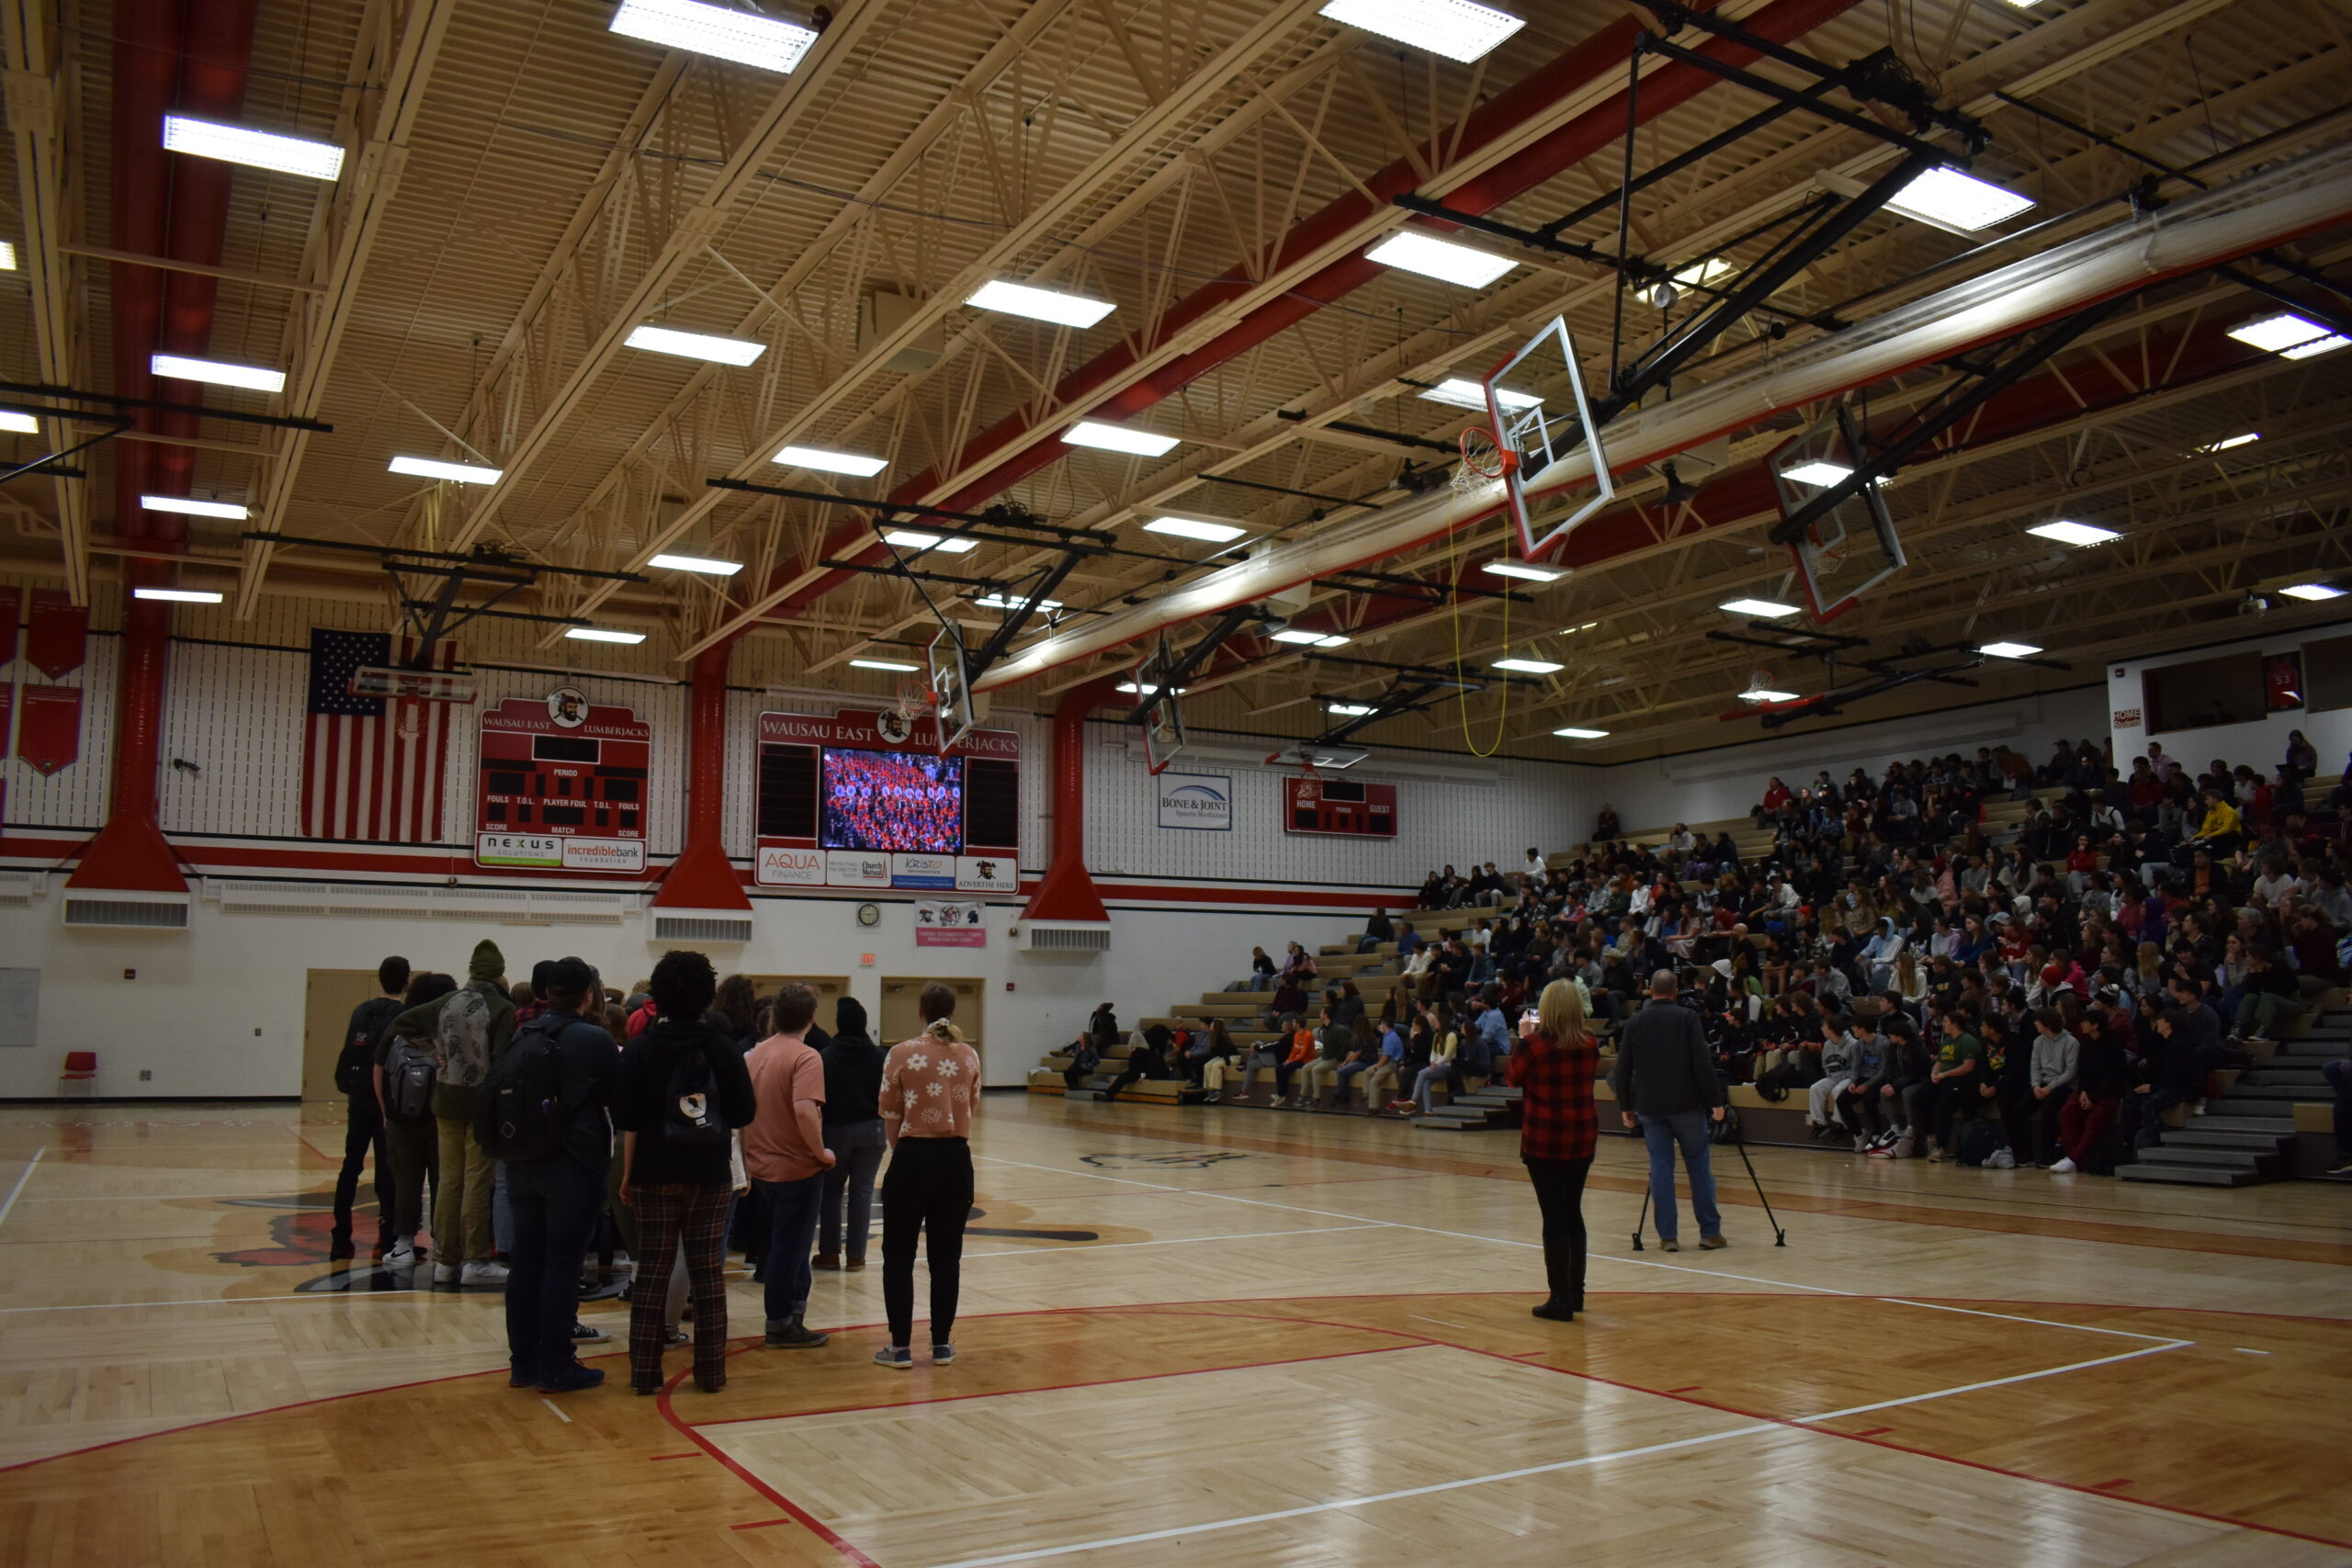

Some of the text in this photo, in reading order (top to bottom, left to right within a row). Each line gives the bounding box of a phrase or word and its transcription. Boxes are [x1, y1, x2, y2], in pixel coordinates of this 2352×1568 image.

[2113, 708, 2141, 720] HOME
[484, 716, 551, 730] WAUSAU EAST
[584, 725, 649, 738] LUMBERJACKS
[763, 719, 875, 742] WAUSAU EAST
[553, 768, 578, 777] PERIOD
[487, 795, 509, 804] FOULS
[544, 798, 587, 808] PLAYER FOUL
[1162, 797, 1227, 811] BONE & JOINT
[1296, 800, 1316, 808] HOME
[1370, 805, 1389, 814] GUEST
[1198, 811, 1227, 819] Medicine
[485, 823, 507, 831] SCORE
[551, 827, 575, 835] MATCH
[498, 850, 545, 858] SOLUTIONS
[568, 845, 639, 858] incrediblebank
[765, 853, 820, 869] AQUA
[862, 861, 882, 869] Church
[906, 858, 943, 869] KRISTO
[772, 870, 812, 879] FINANCE
